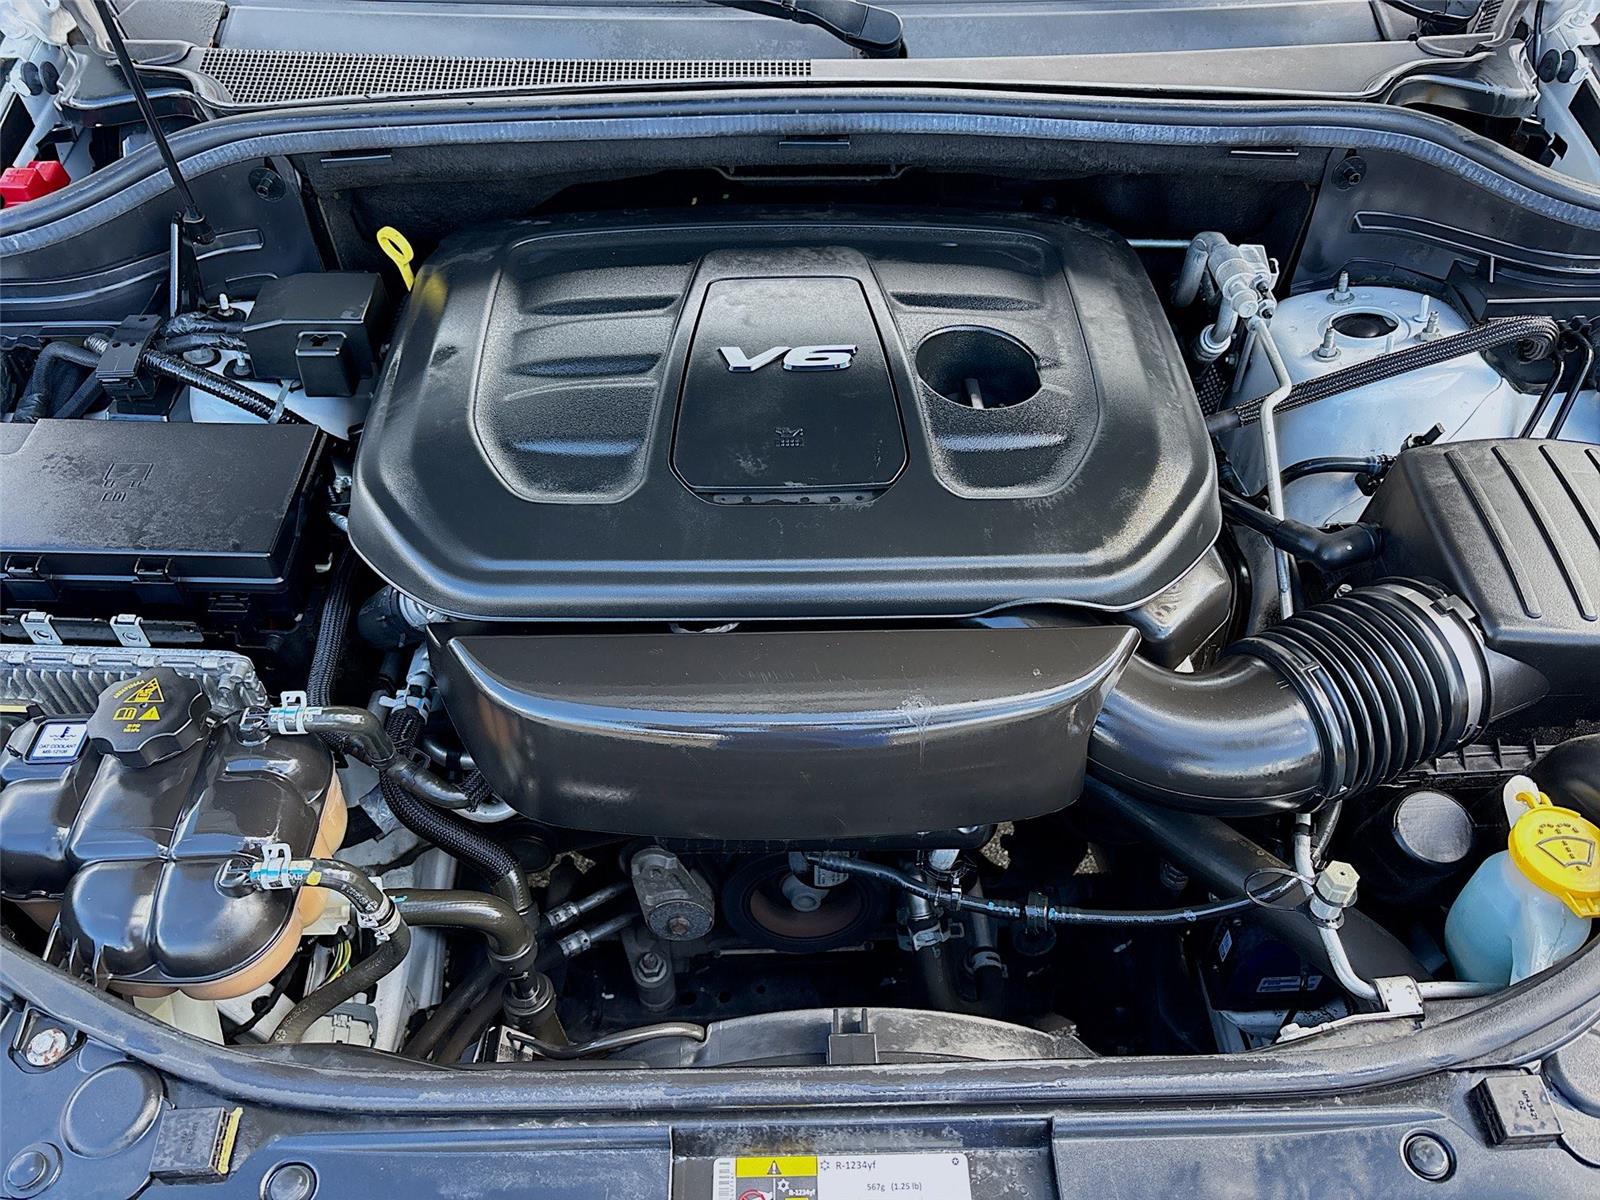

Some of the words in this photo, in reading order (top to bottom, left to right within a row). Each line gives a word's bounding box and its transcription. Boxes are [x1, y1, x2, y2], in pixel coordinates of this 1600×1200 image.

[718, 345, 858, 372] V6
[835, 1161, 876, 1171] R-1234yf
[867, 1184, 886, 1192] 567g
[891, 1183, 910, 1191] (1.25
[912, 1183, 922, 1191] lb)
